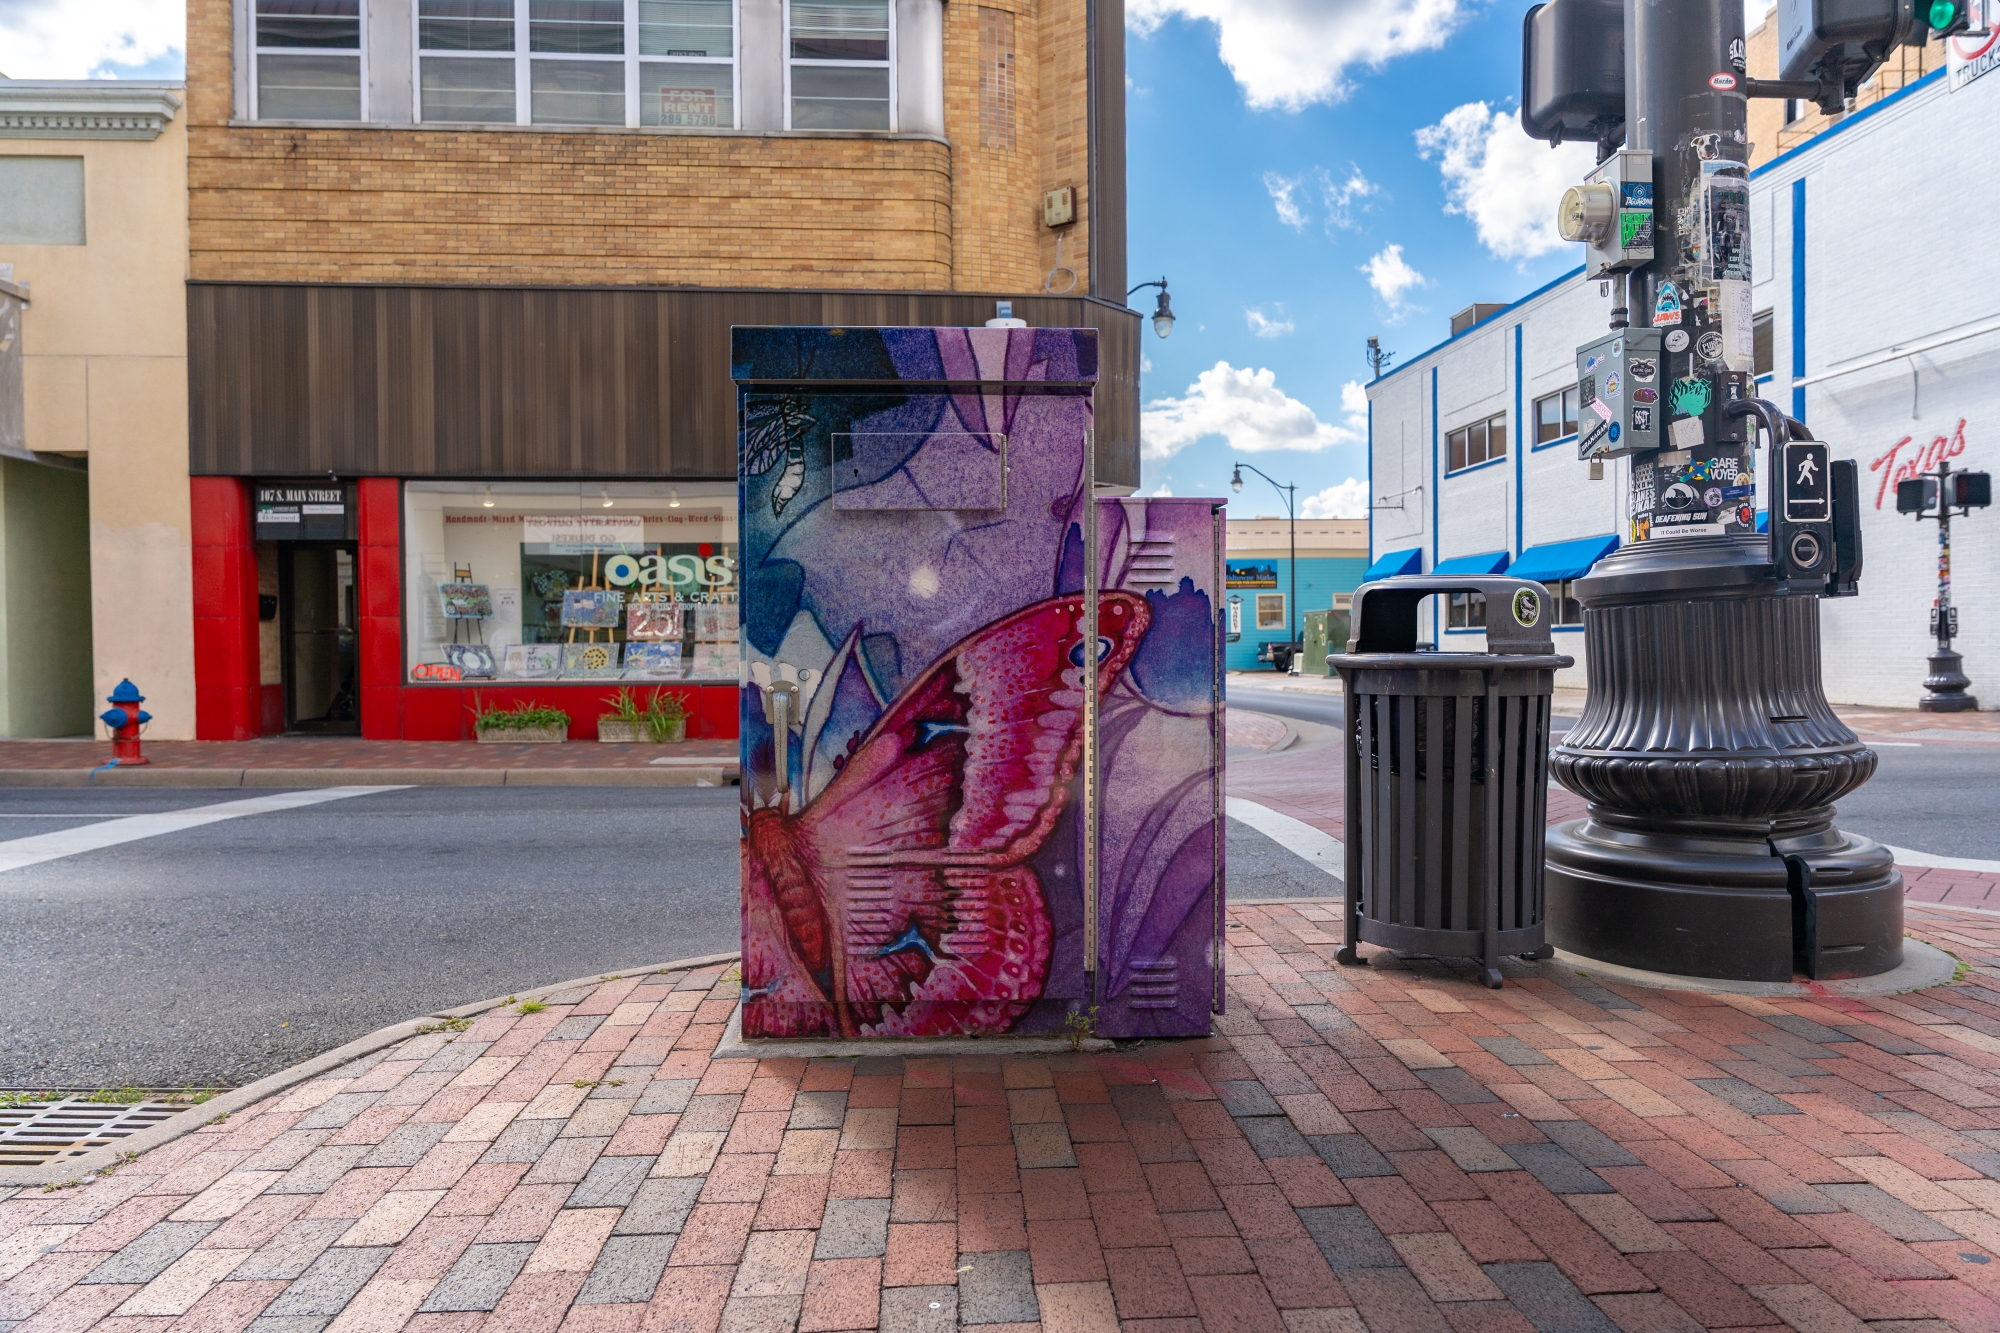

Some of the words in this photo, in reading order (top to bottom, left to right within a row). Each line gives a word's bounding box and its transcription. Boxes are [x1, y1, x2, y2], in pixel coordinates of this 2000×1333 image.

[669, 90, 706, 101] FOR
[664, 103, 712, 113] RENT
[661, 114, 682, 125] 289
[687, 115, 715, 125] 5790
[1653, 311, 1681, 323] JAWS
[1870, 418, 1967, 511] Texas
[260, 489, 275, 502] 107
[276, 489, 284, 502] S.
[286, 489, 307, 502] MAIN
[308, 489, 341, 502] STREET
[604, 543, 733, 586] oasis
[594, 592, 626, 602] FINE
[632, 592, 668, 602] ARTS
[674, 592, 684, 602] &
[690, 592, 739, 602] CRAFT
[632, 608, 680, 637] 25!
[413, 663, 461, 681] OPEN
